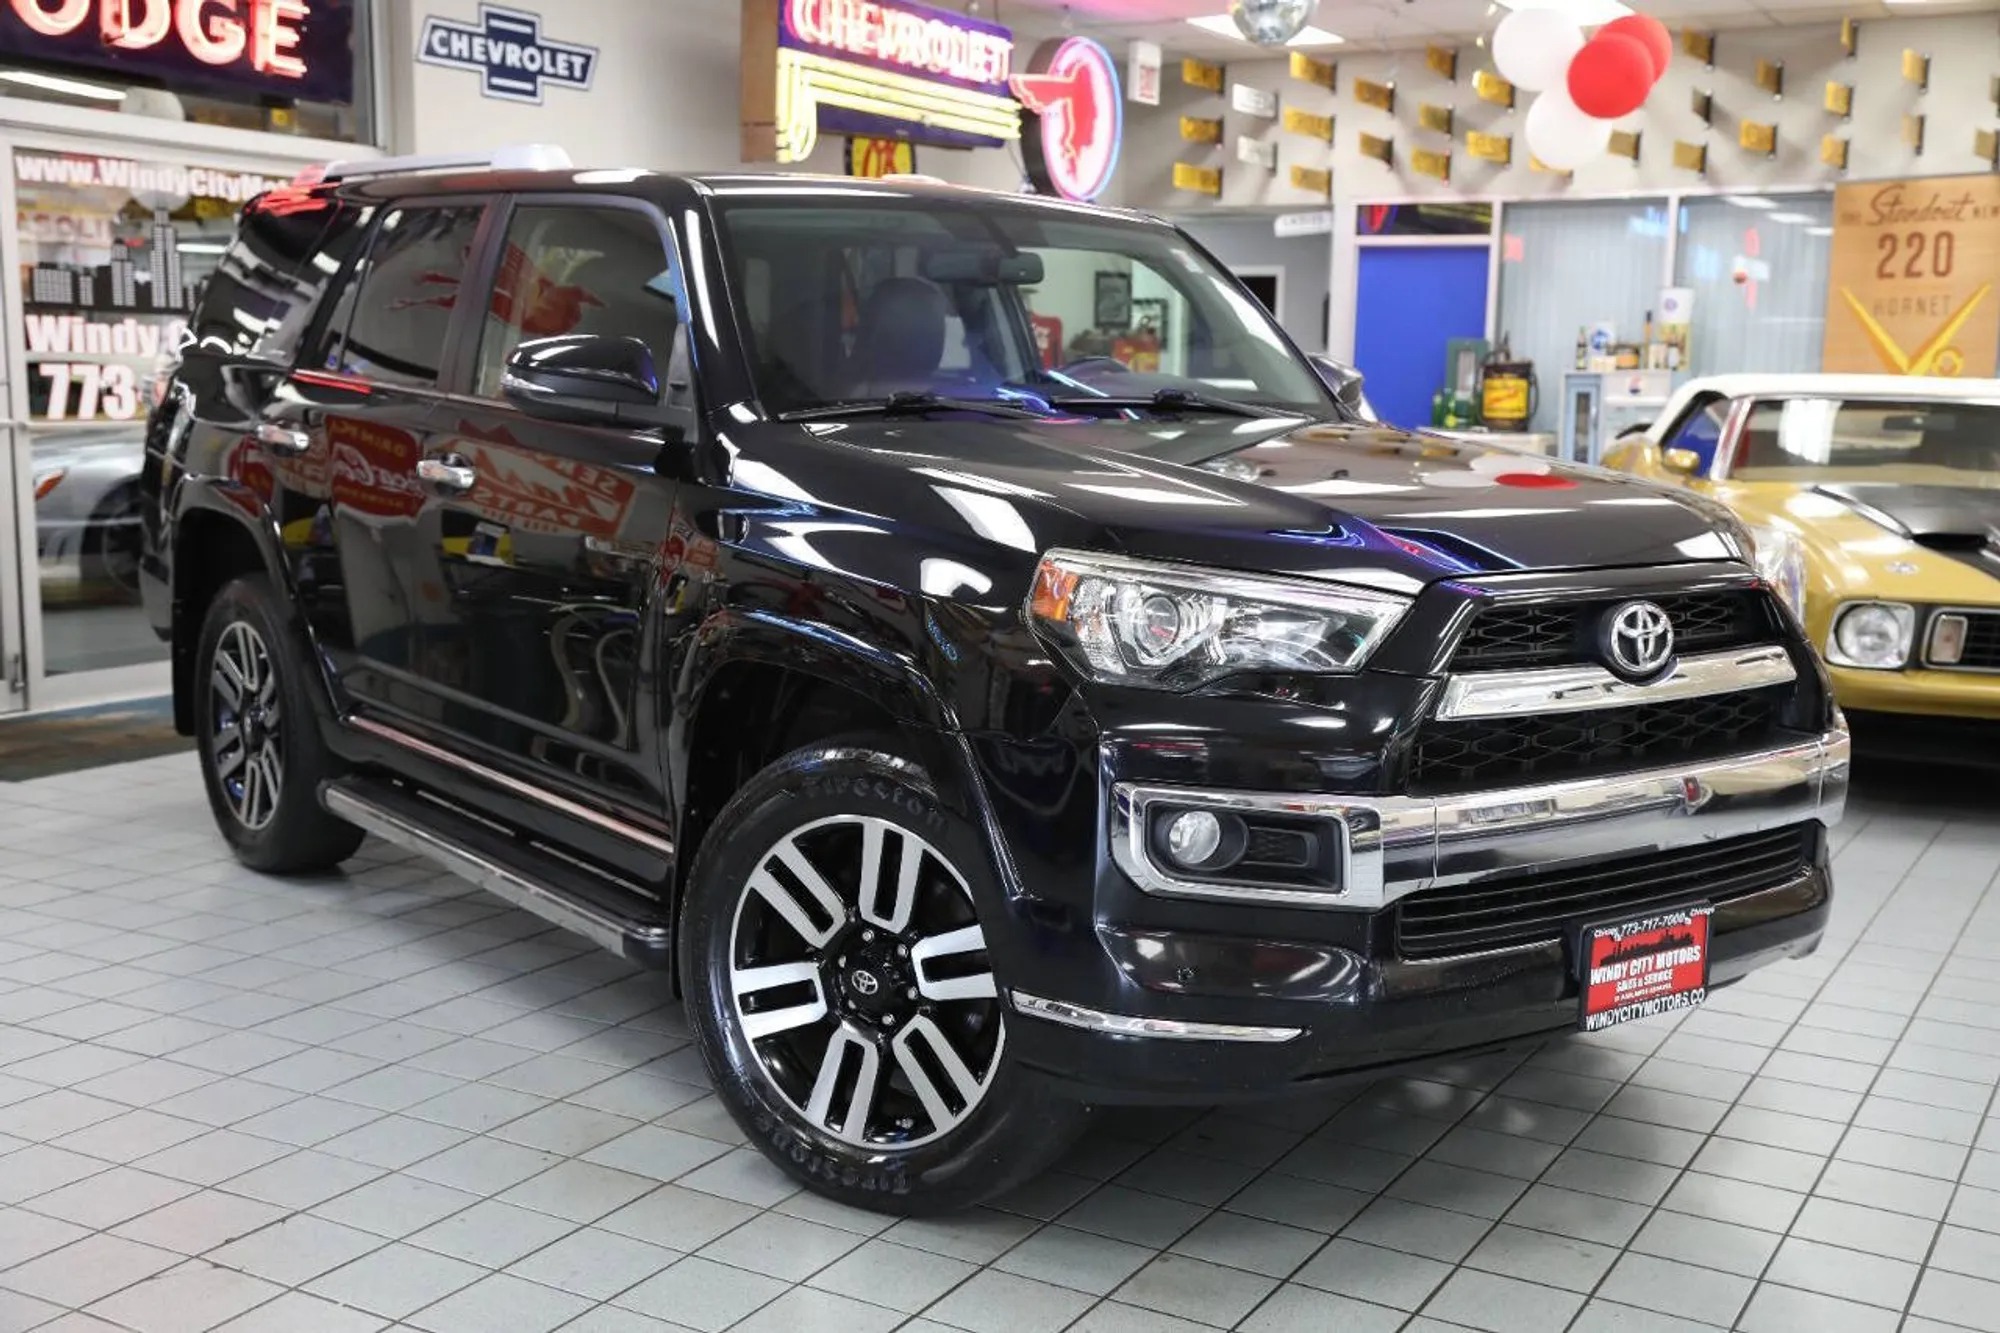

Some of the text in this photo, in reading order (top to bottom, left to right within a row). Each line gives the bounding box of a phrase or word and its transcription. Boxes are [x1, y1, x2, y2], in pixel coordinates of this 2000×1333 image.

[430, 28, 588, 80] CHEVROLET
[1877, 230, 1953, 280] 220
[1873, 295, 1952, 317] HORNET
[25, 314, 160, 357] Windy
[1590, 945, 1702, 985] WINDY CITY MOTORS
[1616, 977, 1636, 992] SALES
[1644, 969, 1674, 985] SERVICE
